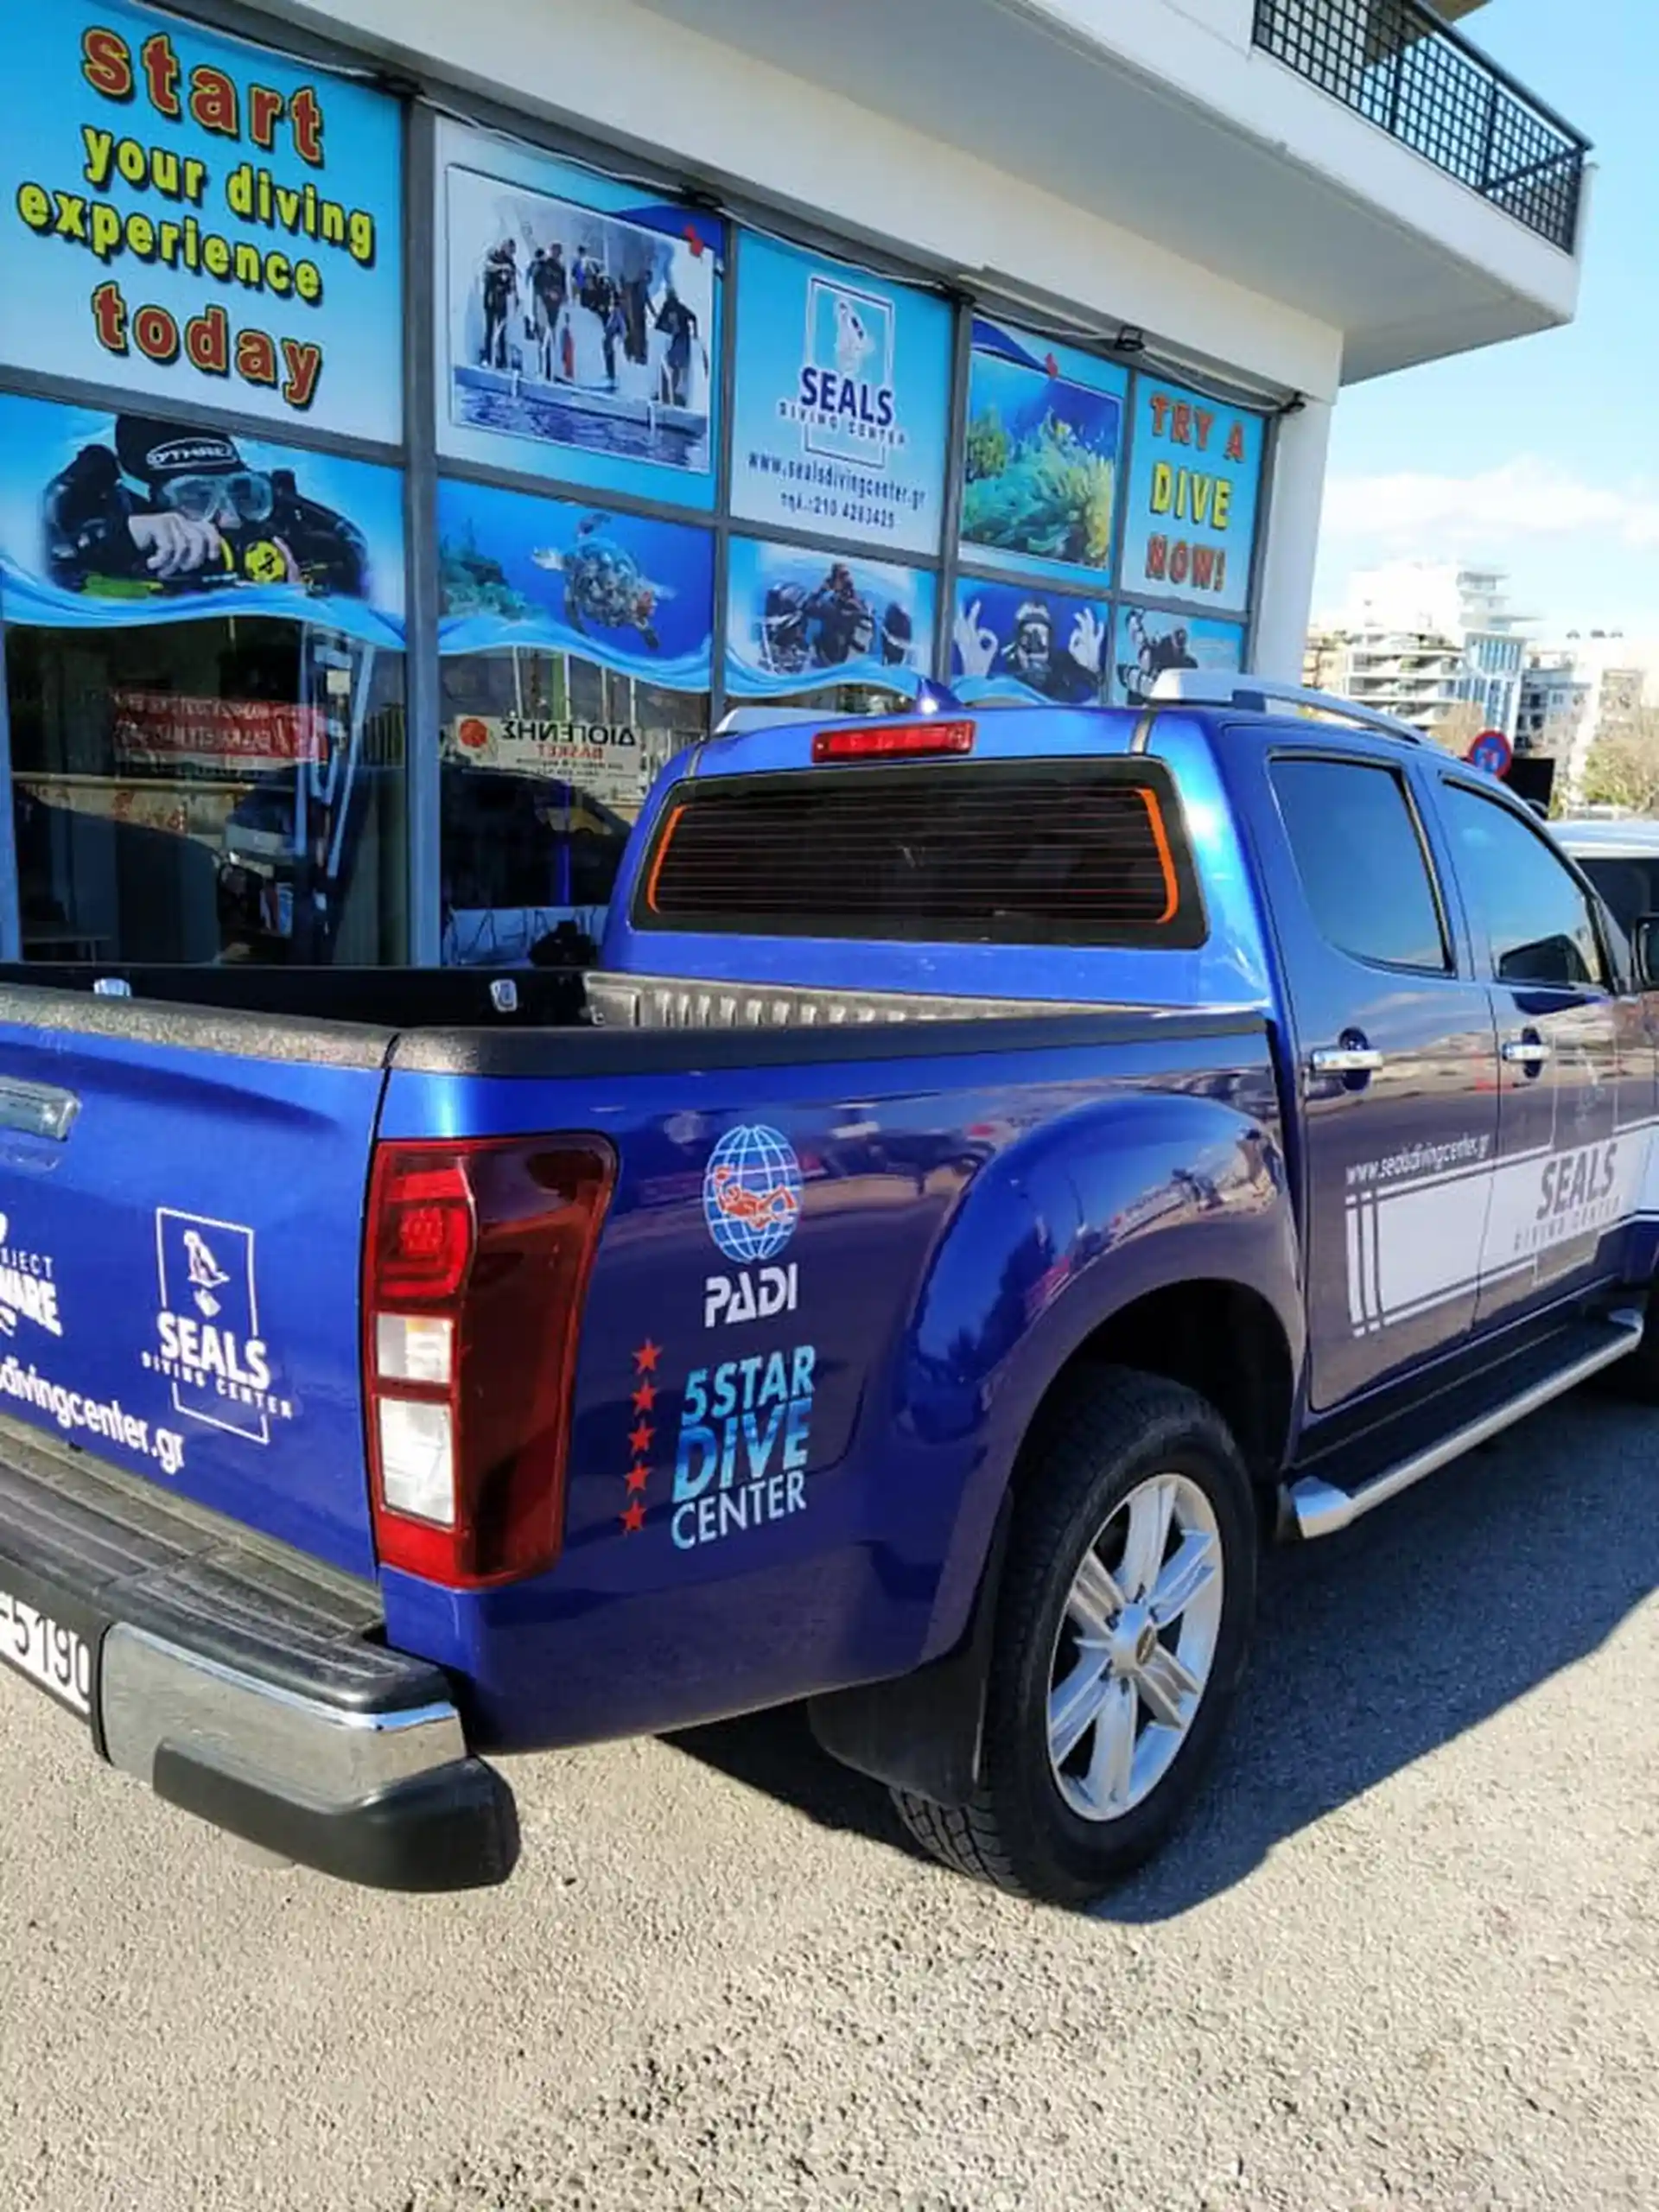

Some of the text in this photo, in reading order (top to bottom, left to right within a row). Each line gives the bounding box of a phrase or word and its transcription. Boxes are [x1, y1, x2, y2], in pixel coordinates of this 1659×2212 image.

[82, 26, 324, 168] start
[82, 124, 375, 266] your diving
[16, 181, 323, 305] experience
[92, 280, 322, 411] today
[800, 366, 893, 427] SEALS
[1149, 392, 1245, 463] TRY A
[748, 451, 926, 511] www.sealsdivingcenter.gr
[1150, 461, 1232, 531] DIVE
[1146, 531, 1226, 592] NOW!
[1536, 1142, 1618, 1221] SEALS
[705, 1262, 798, 1328] PADI
[157, 1310, 270, 1390] SEALS
[710, 1344, 817, 1421] STAR
[0, 1354, 185, 1476] divingcenter.gr
[216, 1377, 293, 1421] CENTER
[671, 1396, 814, 1505] DIVE
[671, 1470, 807, 1551] CENTER
